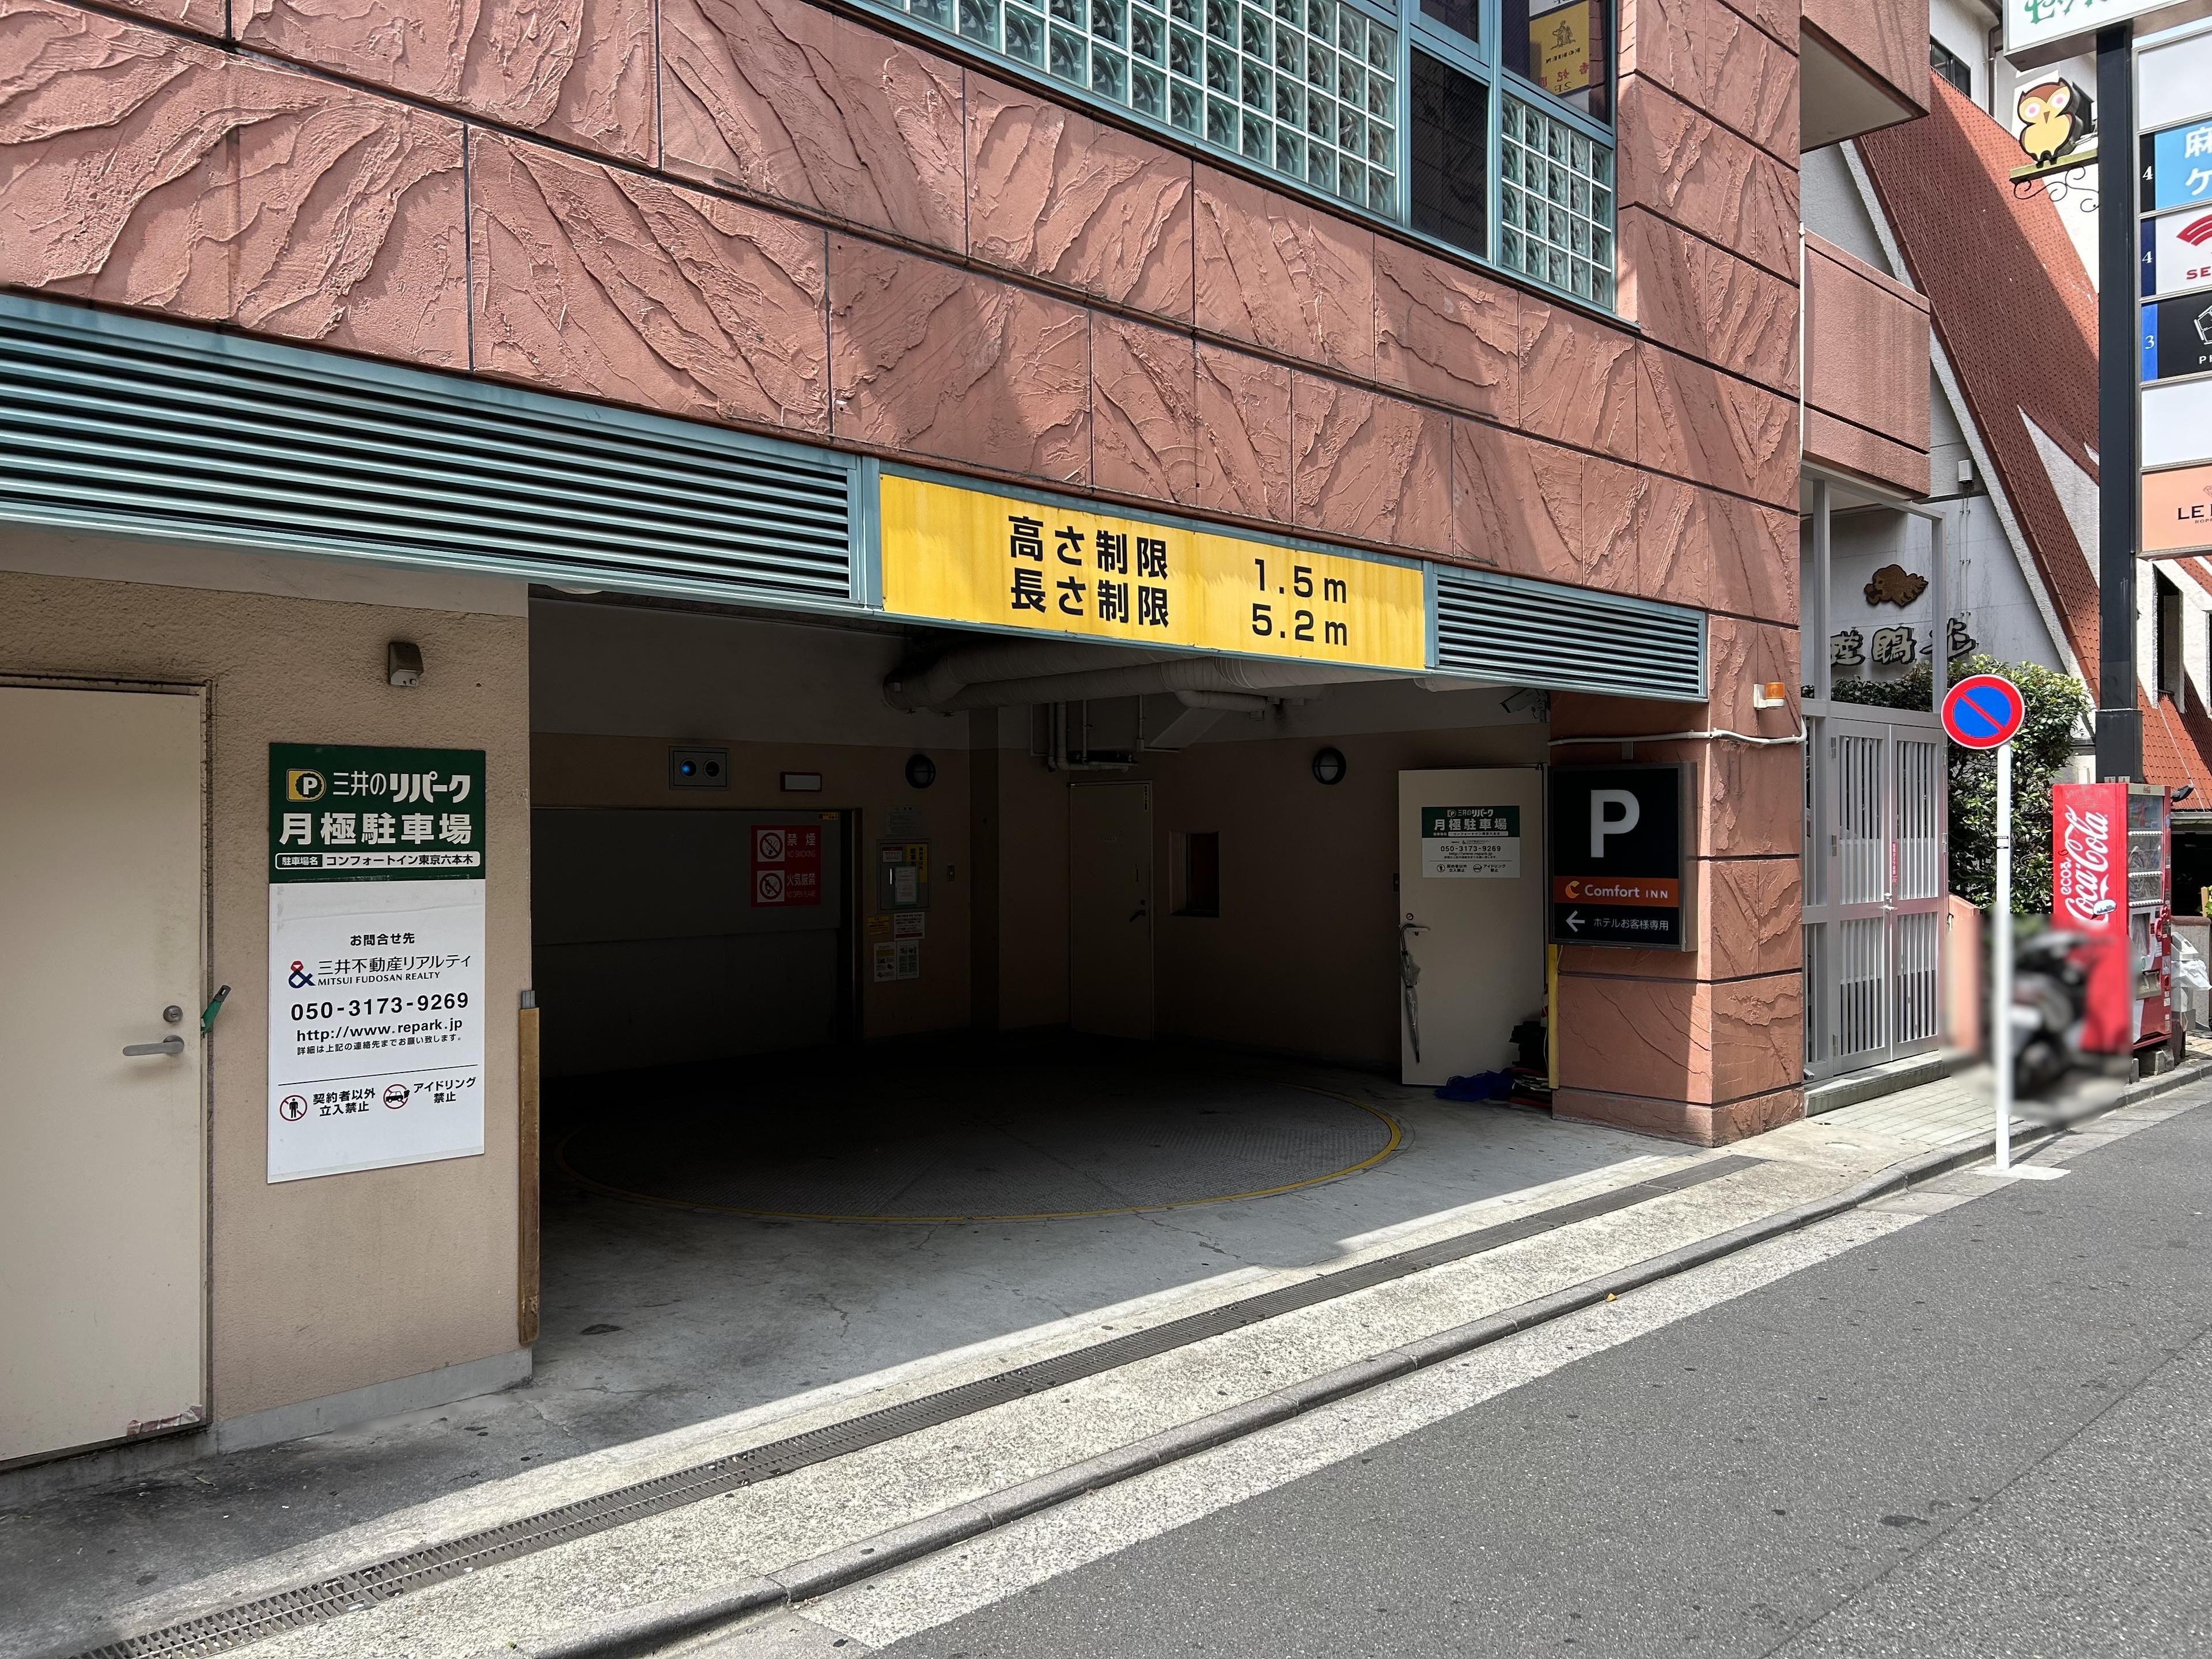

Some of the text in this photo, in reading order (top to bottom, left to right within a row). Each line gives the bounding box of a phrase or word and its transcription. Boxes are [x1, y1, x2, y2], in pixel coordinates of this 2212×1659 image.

[2142, 165, 2153, 180] 4
[2142, 251, 2153, 264] 4
[2187, 266, 2211, 279] SE
[2145, 335, 2155, 350] 3
[2178, 505, 2205, 520] LE
[1008, 515, 1347, 604] 高さ制限 1.5m
[1010, 567, 1348, 646] 長さ制限 5.2m
[332, 771, 471, 804] 三井のリパーク
[279, 812, 472, 846] 月極駐車場
[1434, 818, 1508, 831] 月極駐車場
[1591, 789, 1640, 858] P
[282, 854, 474, 866] 駐車場名 コンフォートイン東京六本木
[1585, 883, 1668, 899] Comfort INN
[1593, 916, 1669, 931] ホテルお客様専用
[350, 932, 415, 946] お問合せ先
[318, 954, 471, 976] 三井不動産リアルティ
[318, 971, 440, 986] MITSUI FUDOSAN REALTY
[291, 991, 469, 1021] 050-3173-9269
[297, 1017, 463, 1043] http://www.repark.jp
[413, 1076, 476, 1094] アイドリング
[313, 1087, 376, 1105] 契約者以外
[433, 1091, 457, 1104] 禁止
[319, 1100, 369, 1118] 立入禁止
